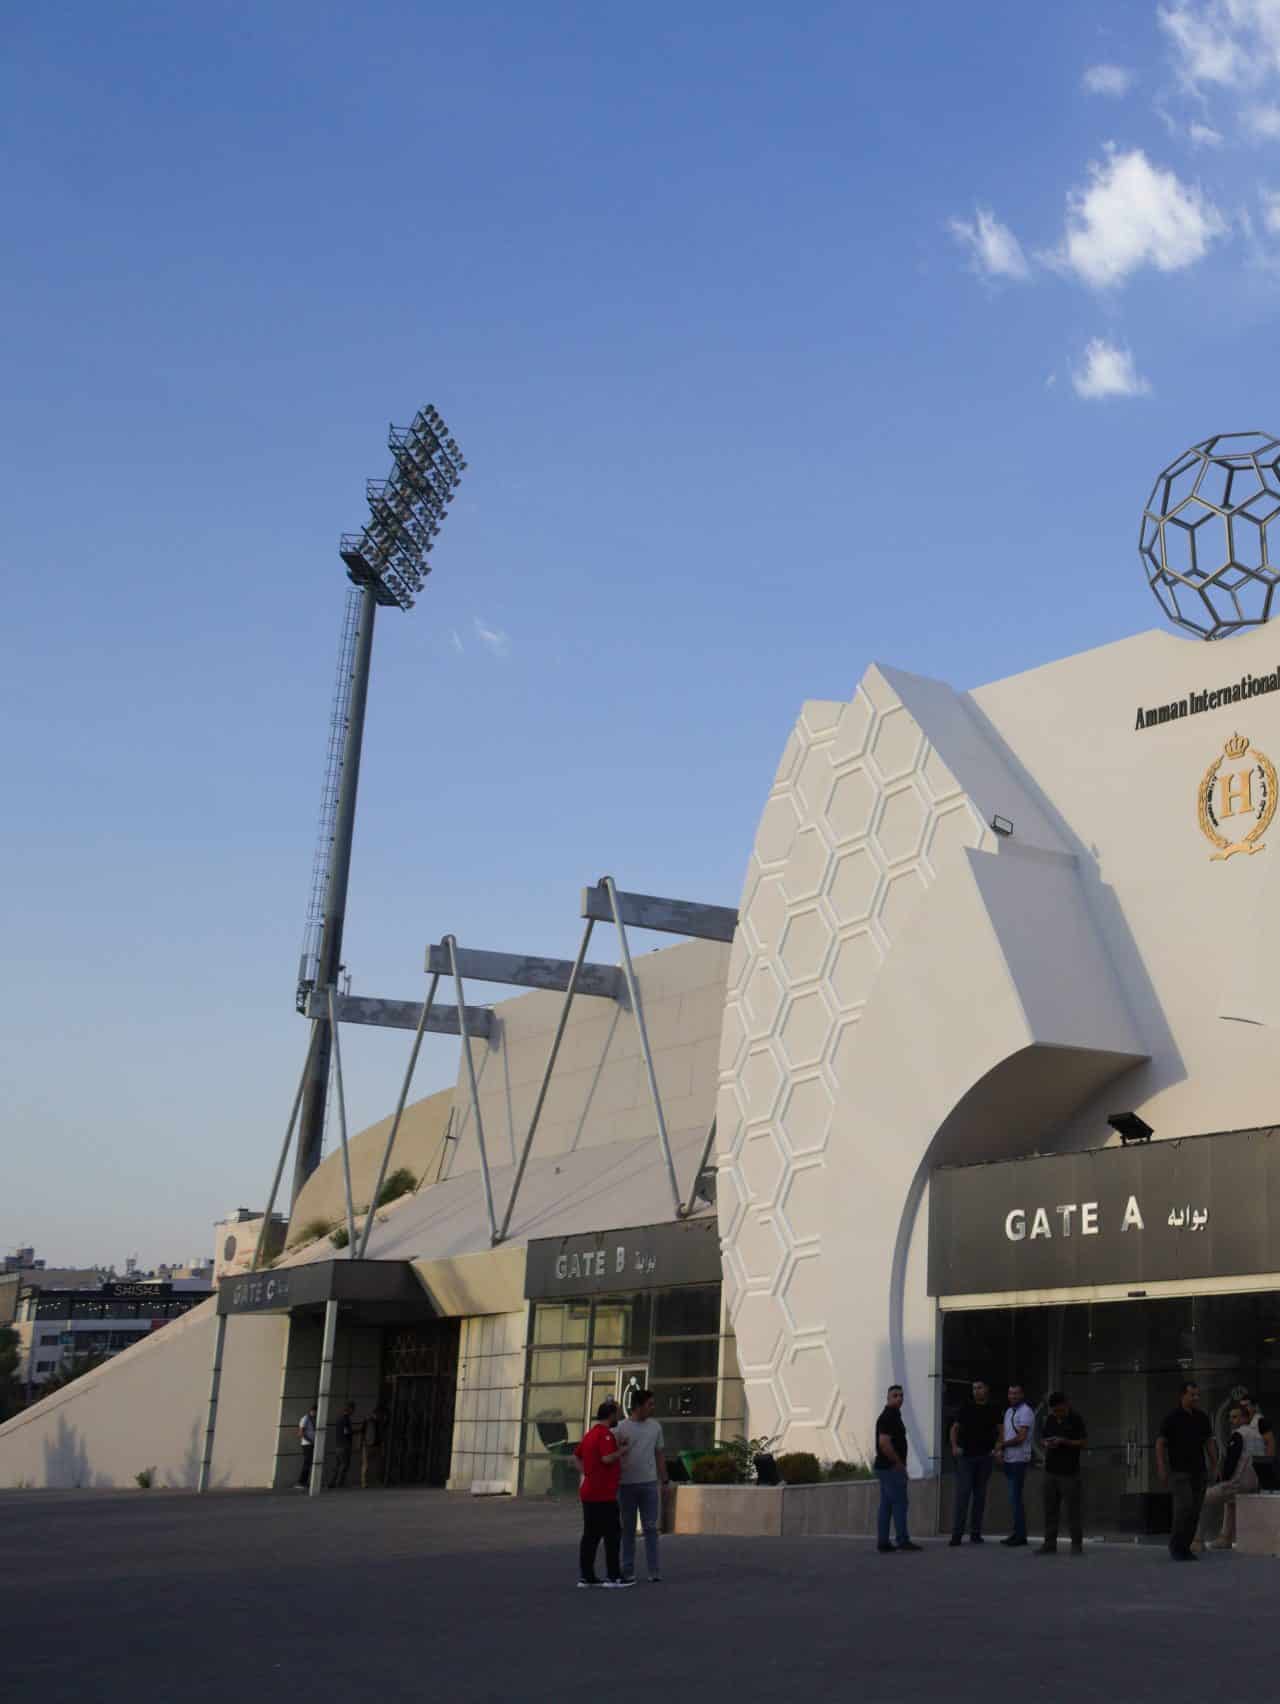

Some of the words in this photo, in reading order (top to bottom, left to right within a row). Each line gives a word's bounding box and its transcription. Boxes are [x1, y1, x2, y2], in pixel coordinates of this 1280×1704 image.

[1135, 699, 1188, 730] Amman
[1219, 768, 1254, 819] H
[1004, 1202, 1100, 1241] GATE
[1121, 1195, 1145, 1232] A
[556, 1250, 606, 1279] GATE
[615, 1246, 626, 1273] B
[232, 1281, 263, 1305] GATE
[266, 1279, 275, 1300] C
